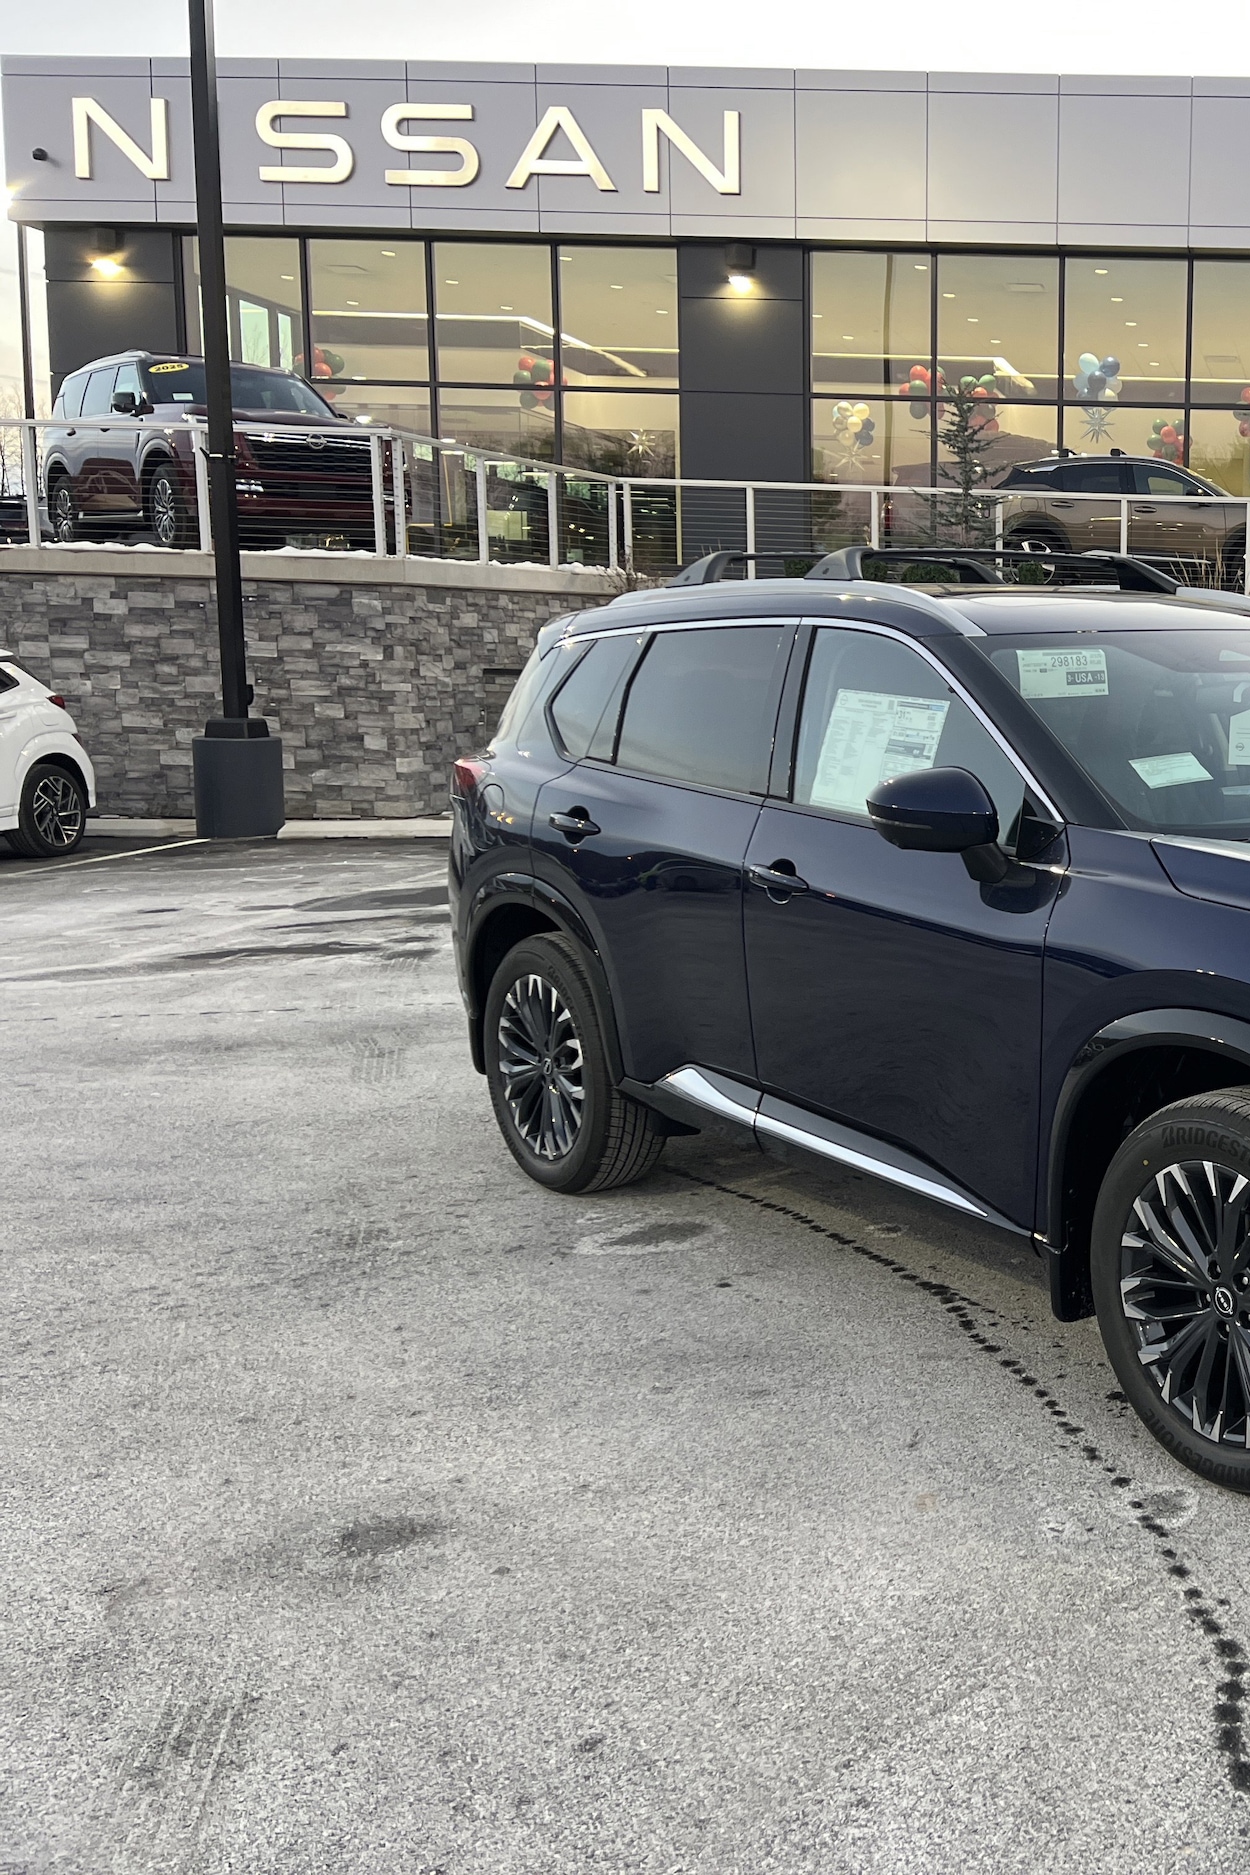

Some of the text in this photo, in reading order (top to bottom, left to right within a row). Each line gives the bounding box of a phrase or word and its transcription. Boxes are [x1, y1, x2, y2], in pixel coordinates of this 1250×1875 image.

[72, 97, 743, 195] NSSAN
[1050, 656, 1088, 668] 298183
[1075, 672, 1093, 683] USA
